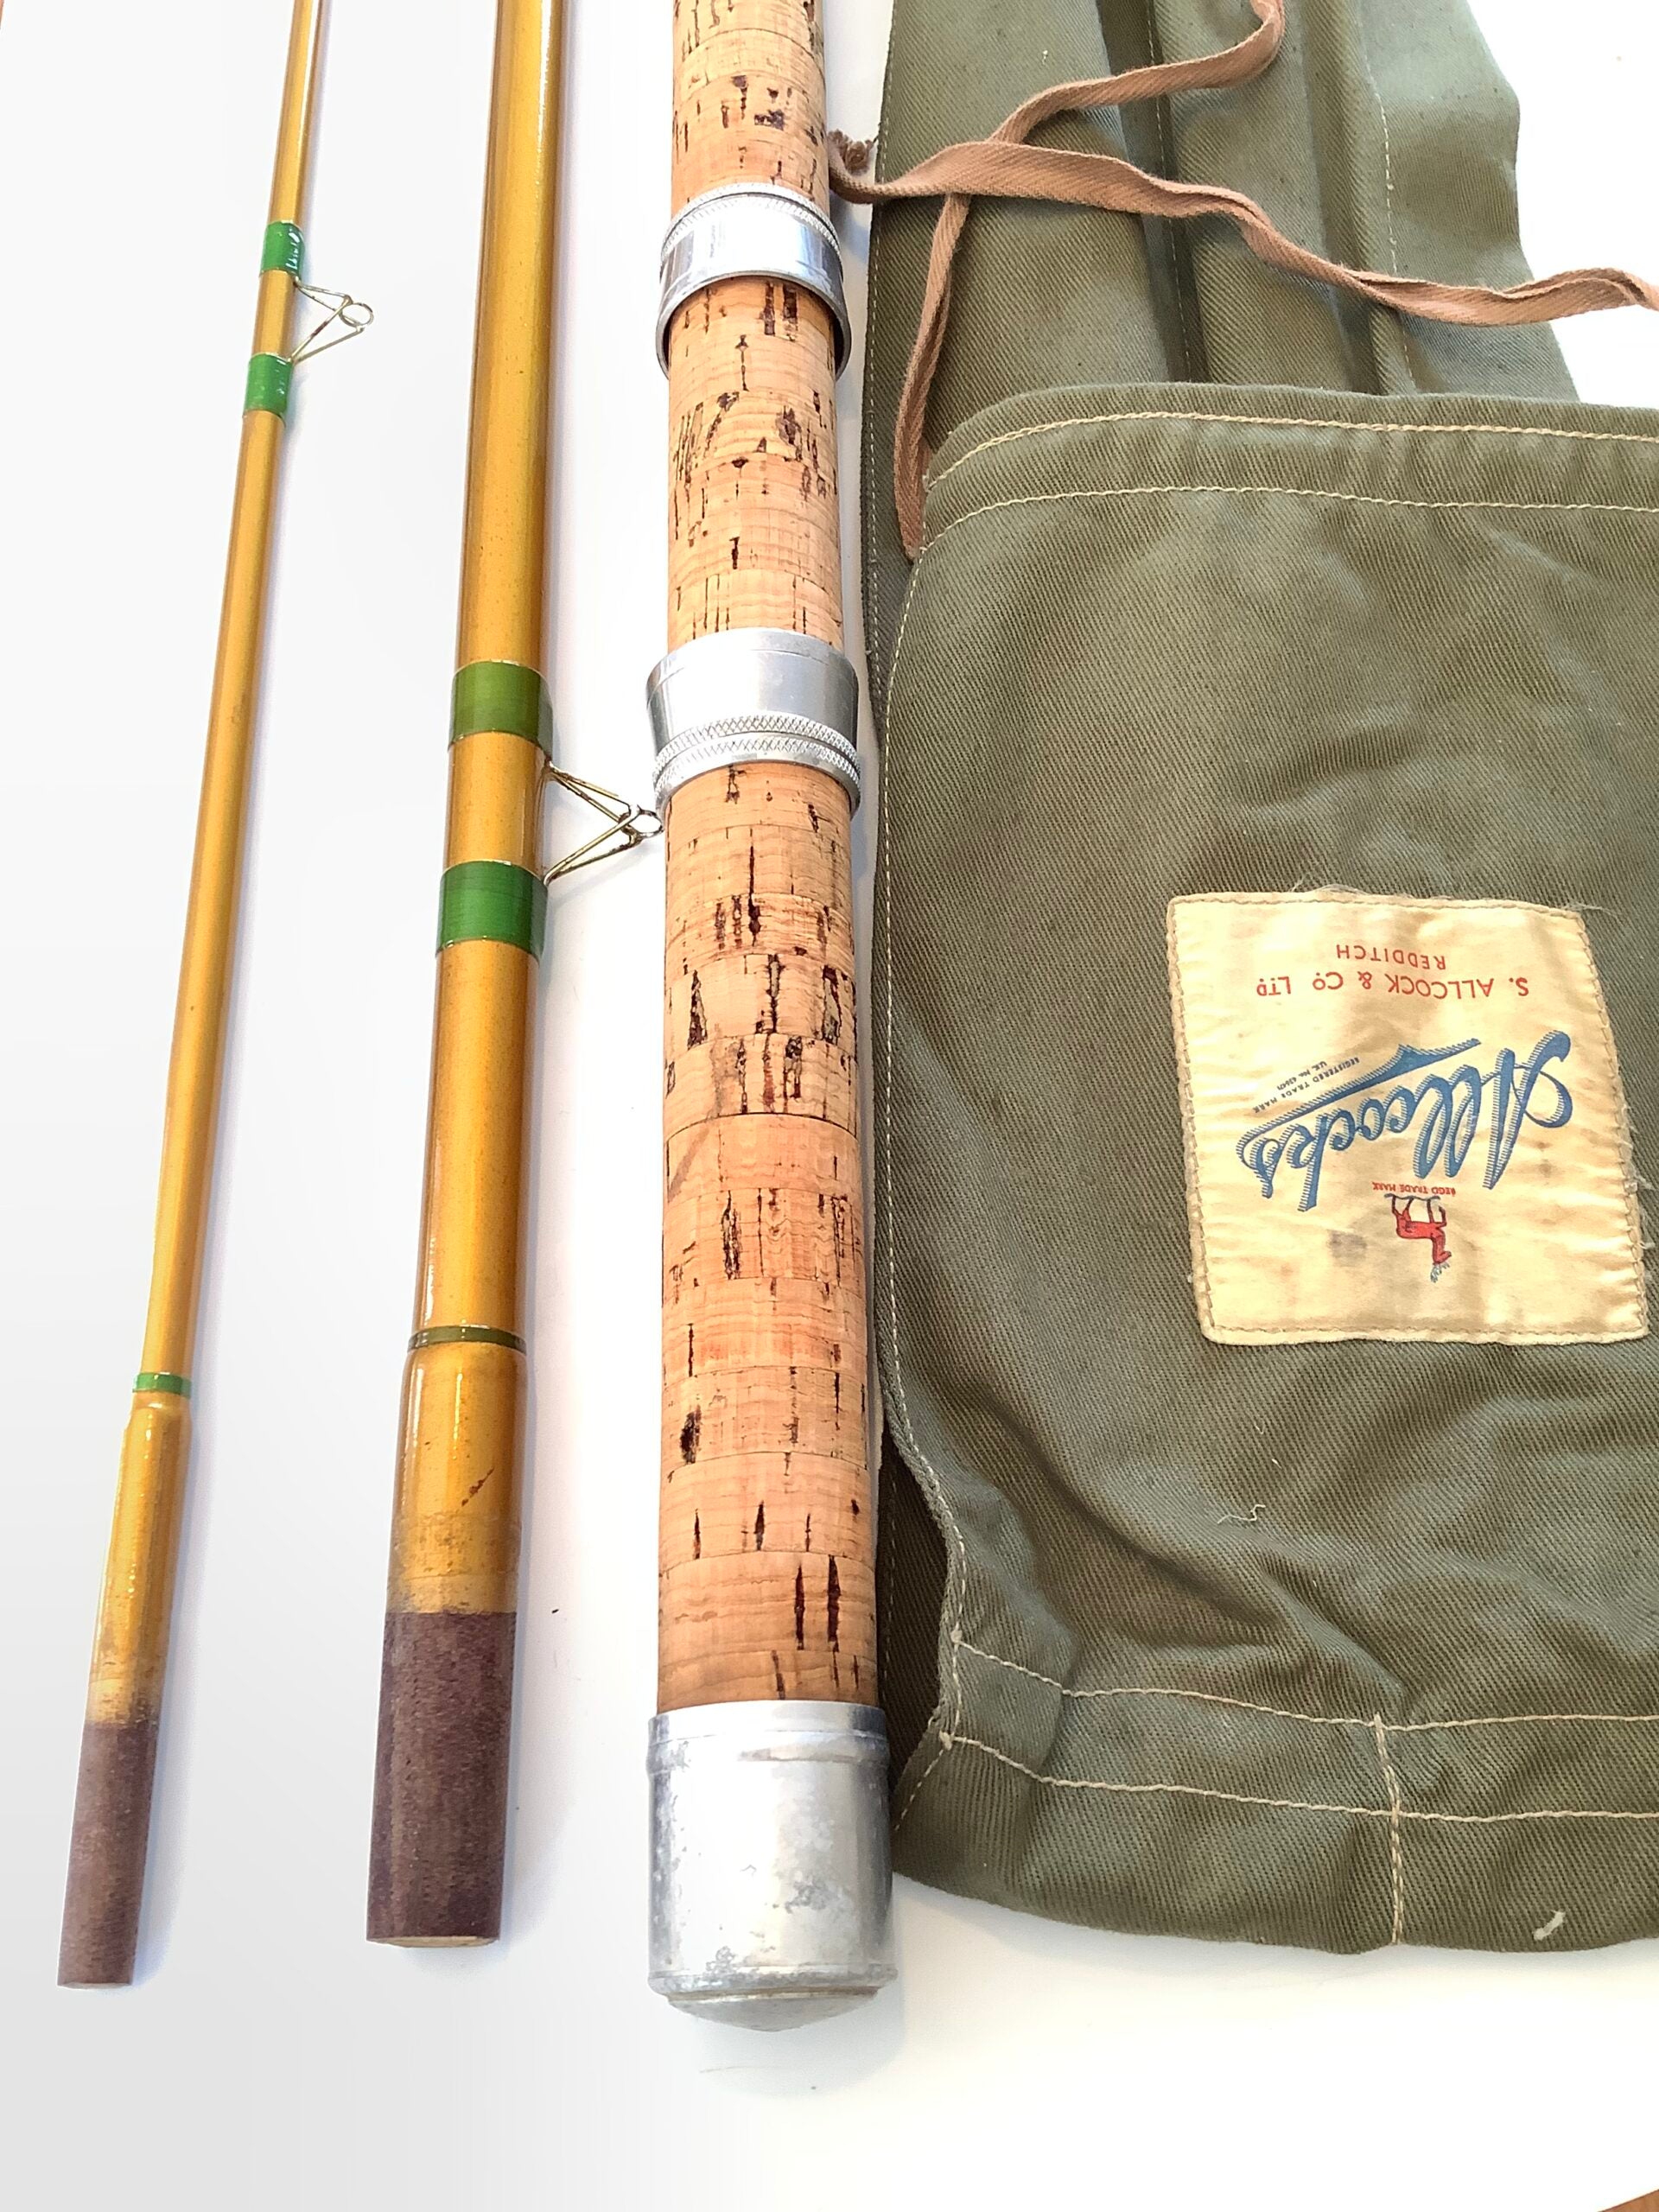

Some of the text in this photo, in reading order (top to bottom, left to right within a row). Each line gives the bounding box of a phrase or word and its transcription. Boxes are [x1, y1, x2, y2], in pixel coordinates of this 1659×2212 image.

[1336, 944, 1446, 970] REDDITCH
[1357, 970, 1372, 990] &
[1384, 973, 1494, 1000] ALLCOCK
[1509, 976, 1529, 997] S.
[1253, 1057, 1360, 1114] REGISTERED TRADE MARK
[1236, 1030, 1573, 1212] Allcocks
[1372, 1181, 1396, 1192] MARK
[1400, 1184, 1428, 1194] TRADE
